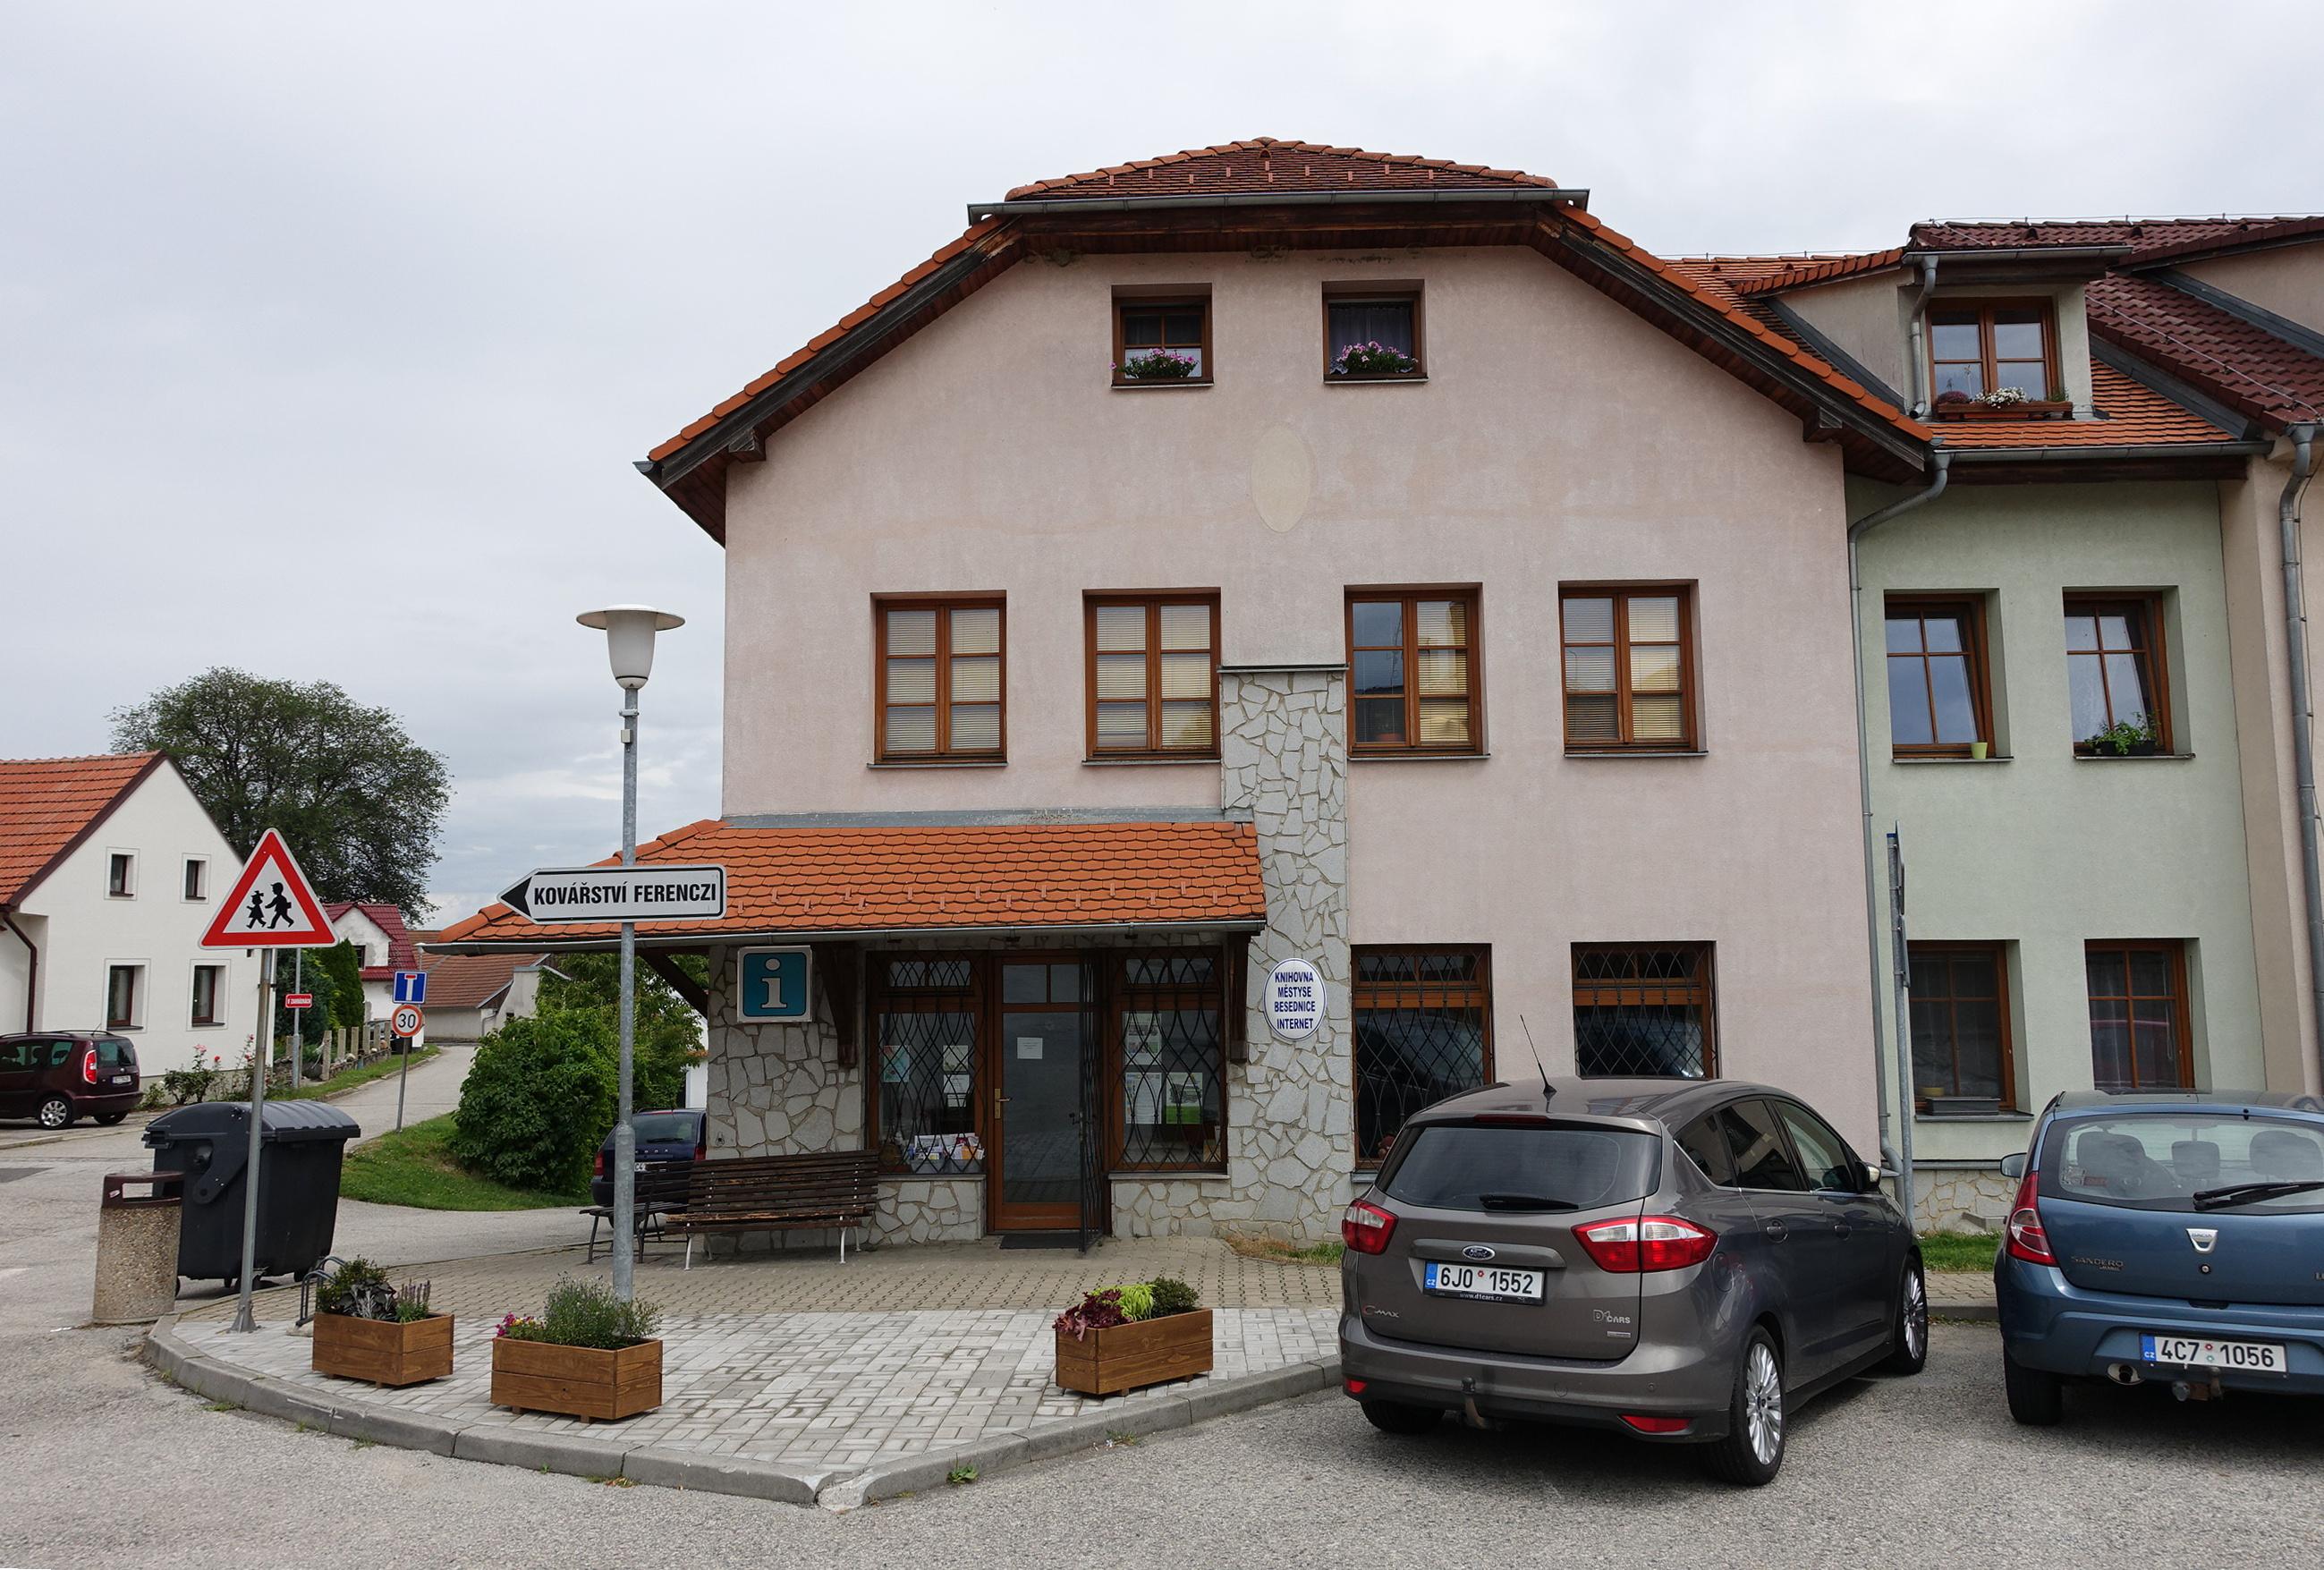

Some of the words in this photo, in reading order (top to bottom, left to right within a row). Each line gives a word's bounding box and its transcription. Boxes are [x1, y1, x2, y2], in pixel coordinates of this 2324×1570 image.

[534, 881, 627, 905] KOVÁŘSTVÍ
[633, 884, 716, 903] FERENCZI
[1275, 972, 1314, 983] KNIHOVNA
[1277, 984, 1311, 997] MĚSTYSE
[1274, 1001, 1316, 1013] BESEDNICE
[398, 1013, 416, 1028] 30
[1277, 1018, 1314, 1030] INTERNET
[1426, 1277, 1436, 1286] CZ
[1440, 1267, 1474, 1288] 6J0
[1489, 1270, 1534, 1294] 1552
[1459, 1292, 1503, 1302] www.d1cars.cz
[2143, 1351, 2155, 1359] CZ
[2161, 1339, 2200, 1362] 4C7
[2219, 1344, 2274, 1367] 1056
